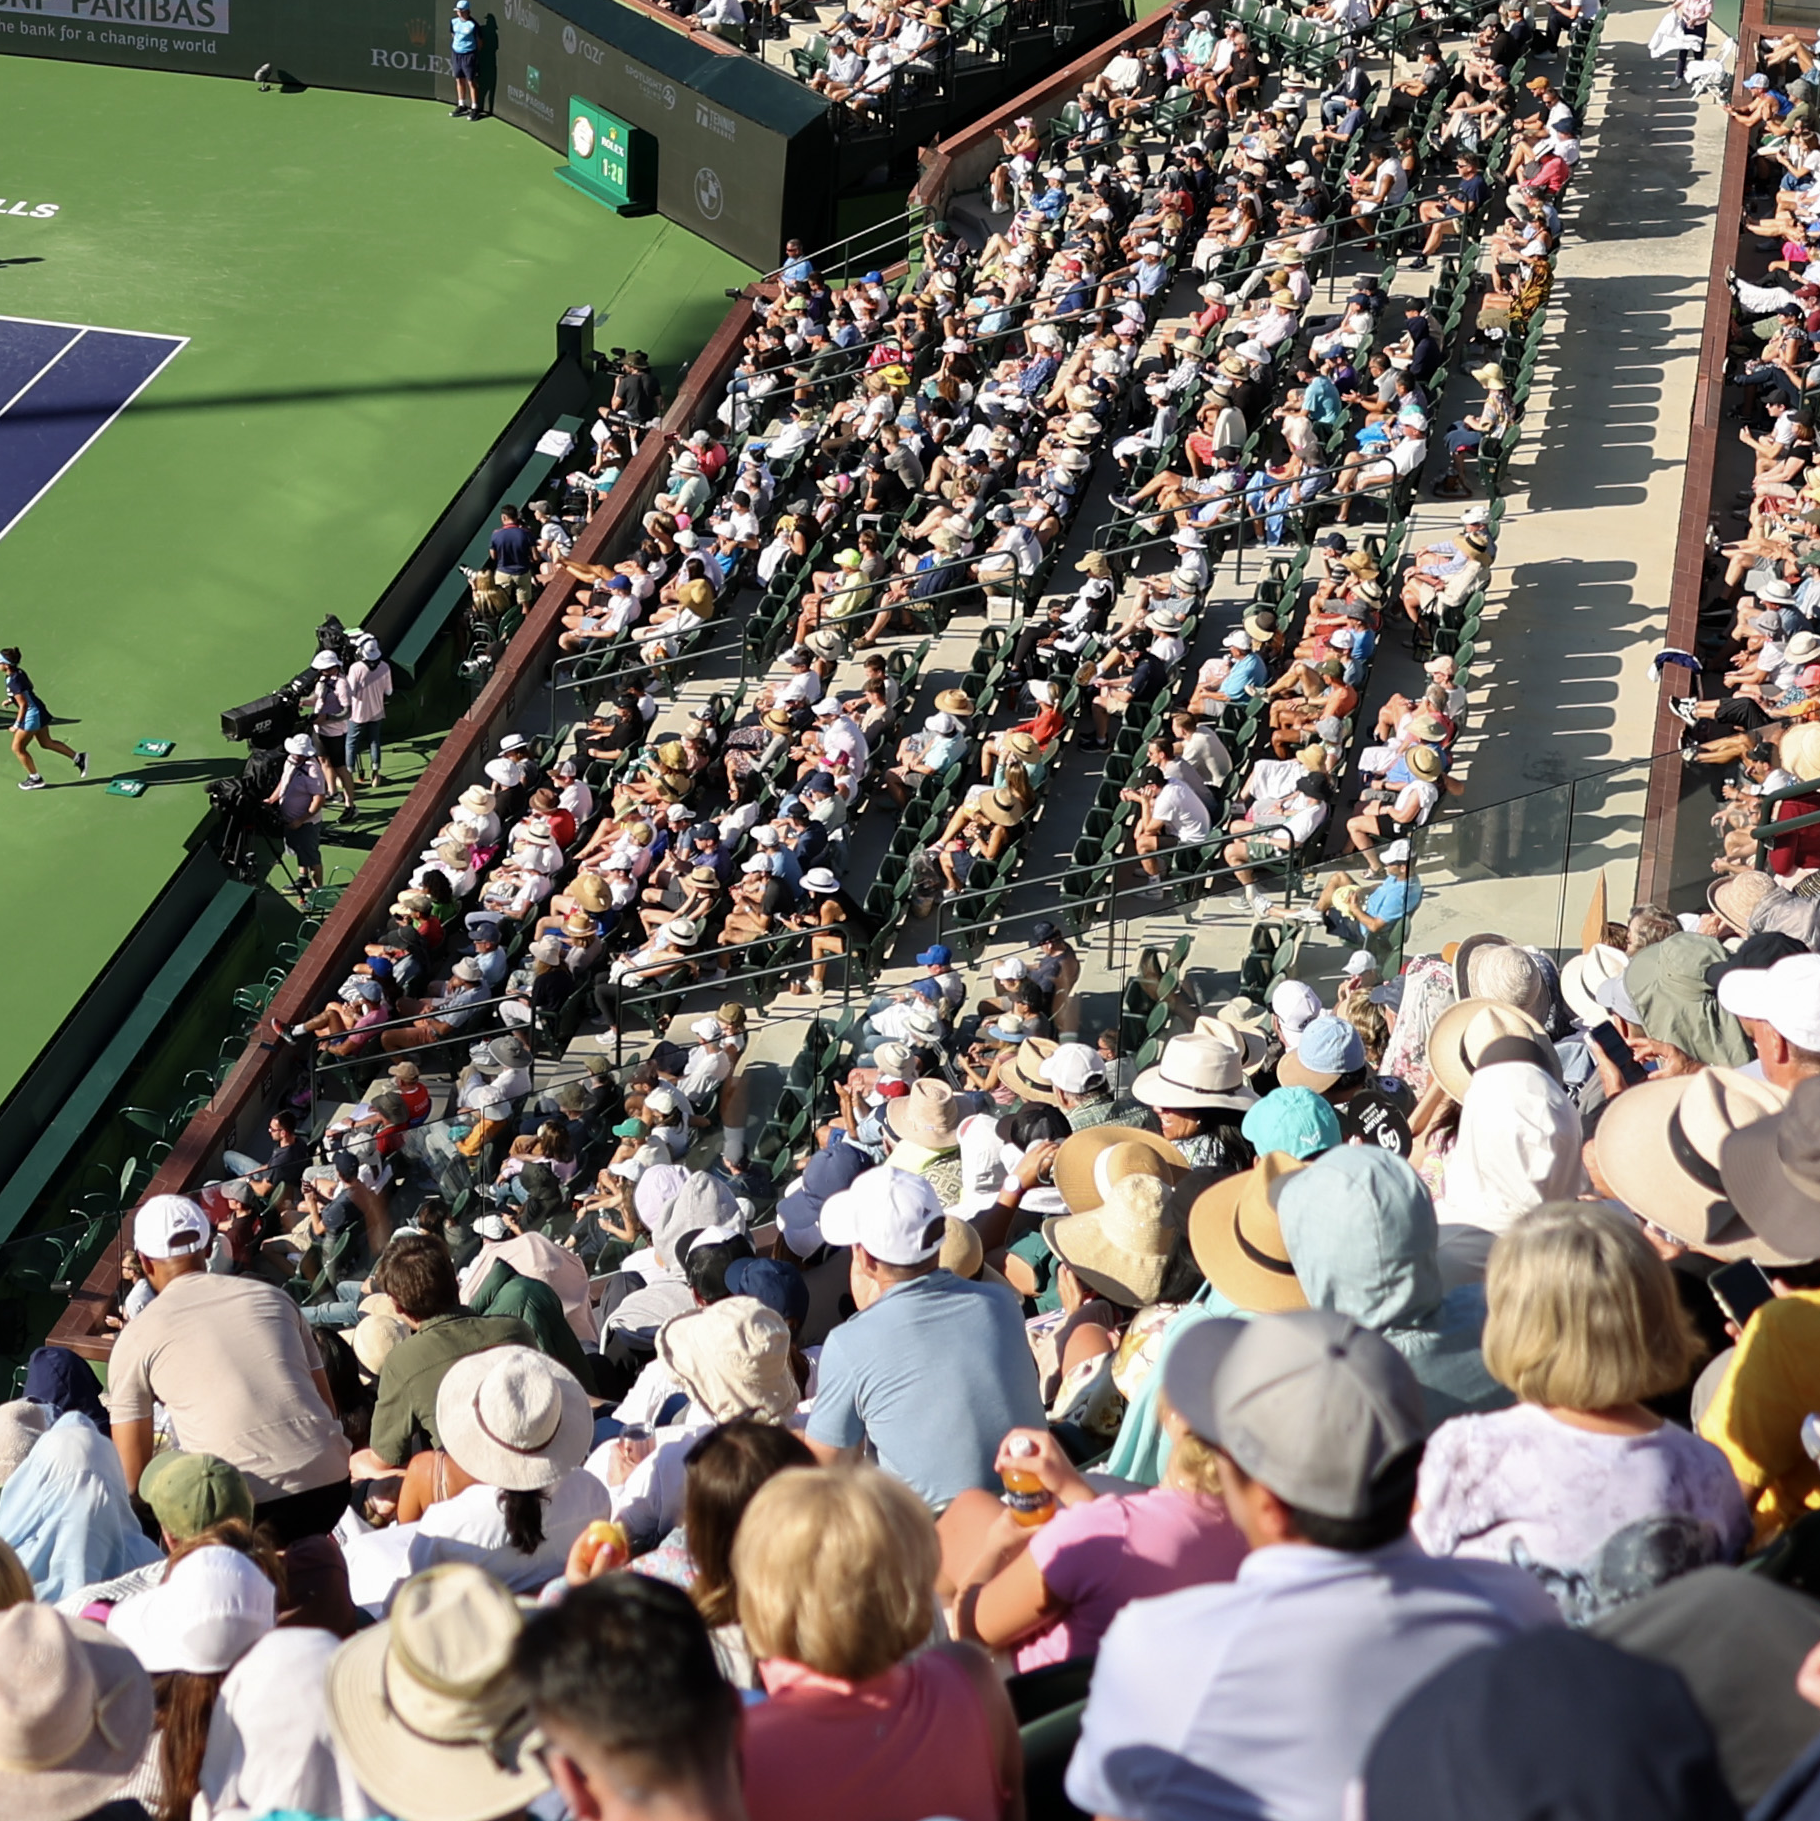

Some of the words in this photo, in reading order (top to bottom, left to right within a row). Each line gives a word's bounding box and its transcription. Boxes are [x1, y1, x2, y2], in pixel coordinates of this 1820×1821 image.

[20, 20, 56, 37] bank
[60, 24, 82, 41] for
[87, 31, 96, 42] a
[100, 29, 168, 53] changing
[172, 38, 217, 54] world
[579, 40, 606, 65] razr
[625, 65, 663, 92] SPOTLIGHT
[526, 93, 554, 118] PARIBAS
[709, 110, 736, 135] TENNIS
[601, 136, 625, 157] ROLEX
